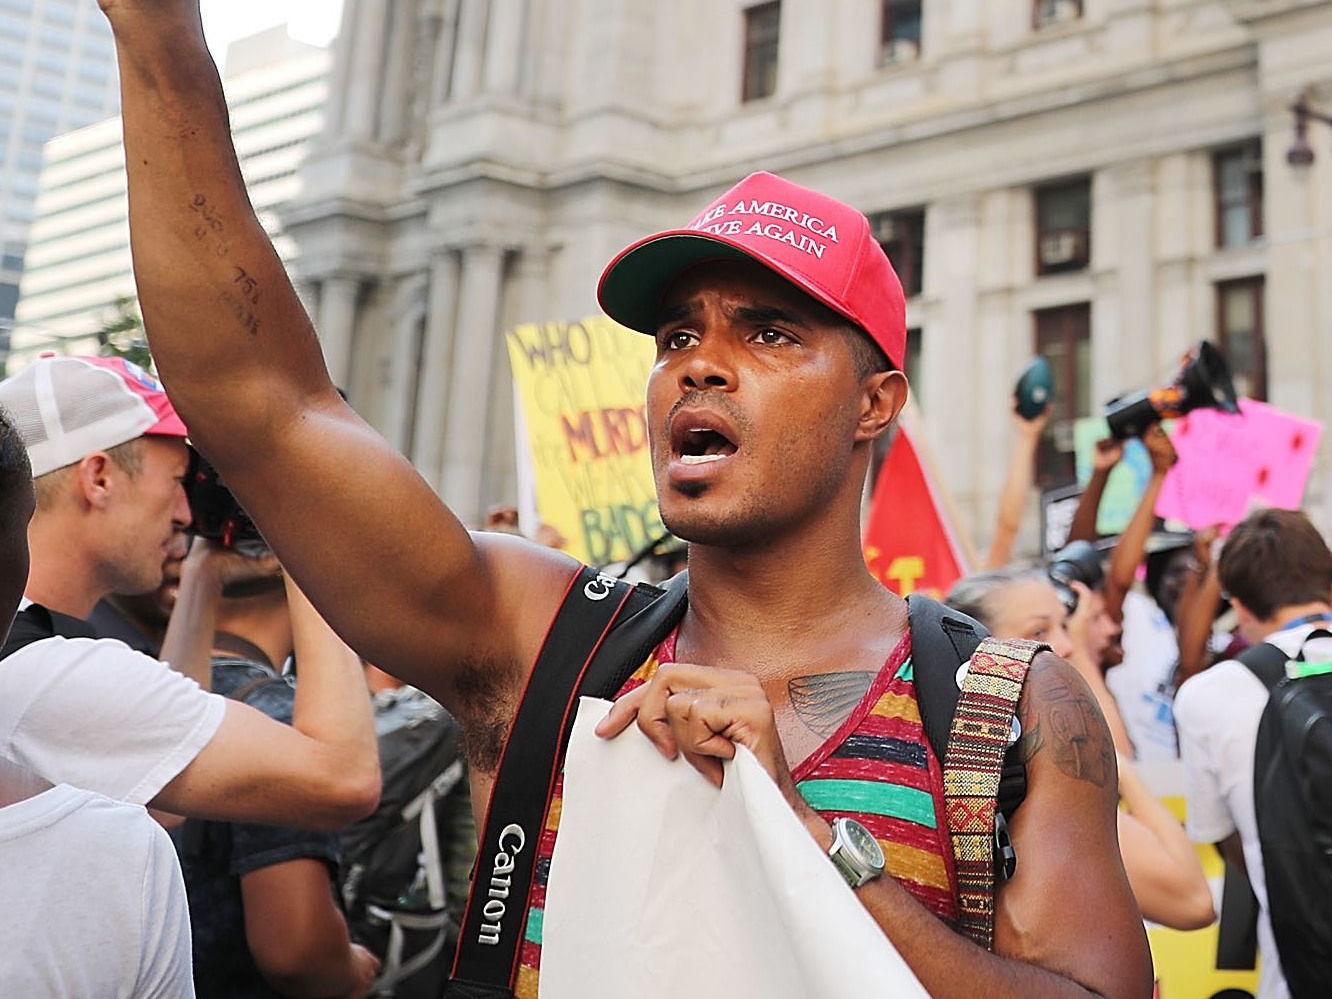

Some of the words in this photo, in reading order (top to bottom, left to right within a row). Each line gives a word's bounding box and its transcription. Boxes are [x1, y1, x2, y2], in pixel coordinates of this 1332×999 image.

[728, 200, 839, 243] AMERICA
[744, 221, 826, 259] AGAIN
[506, 322, 592, 369] WHO
[561, 407, 649, 463] MURD
[478, 823, 526, 946] Canon
